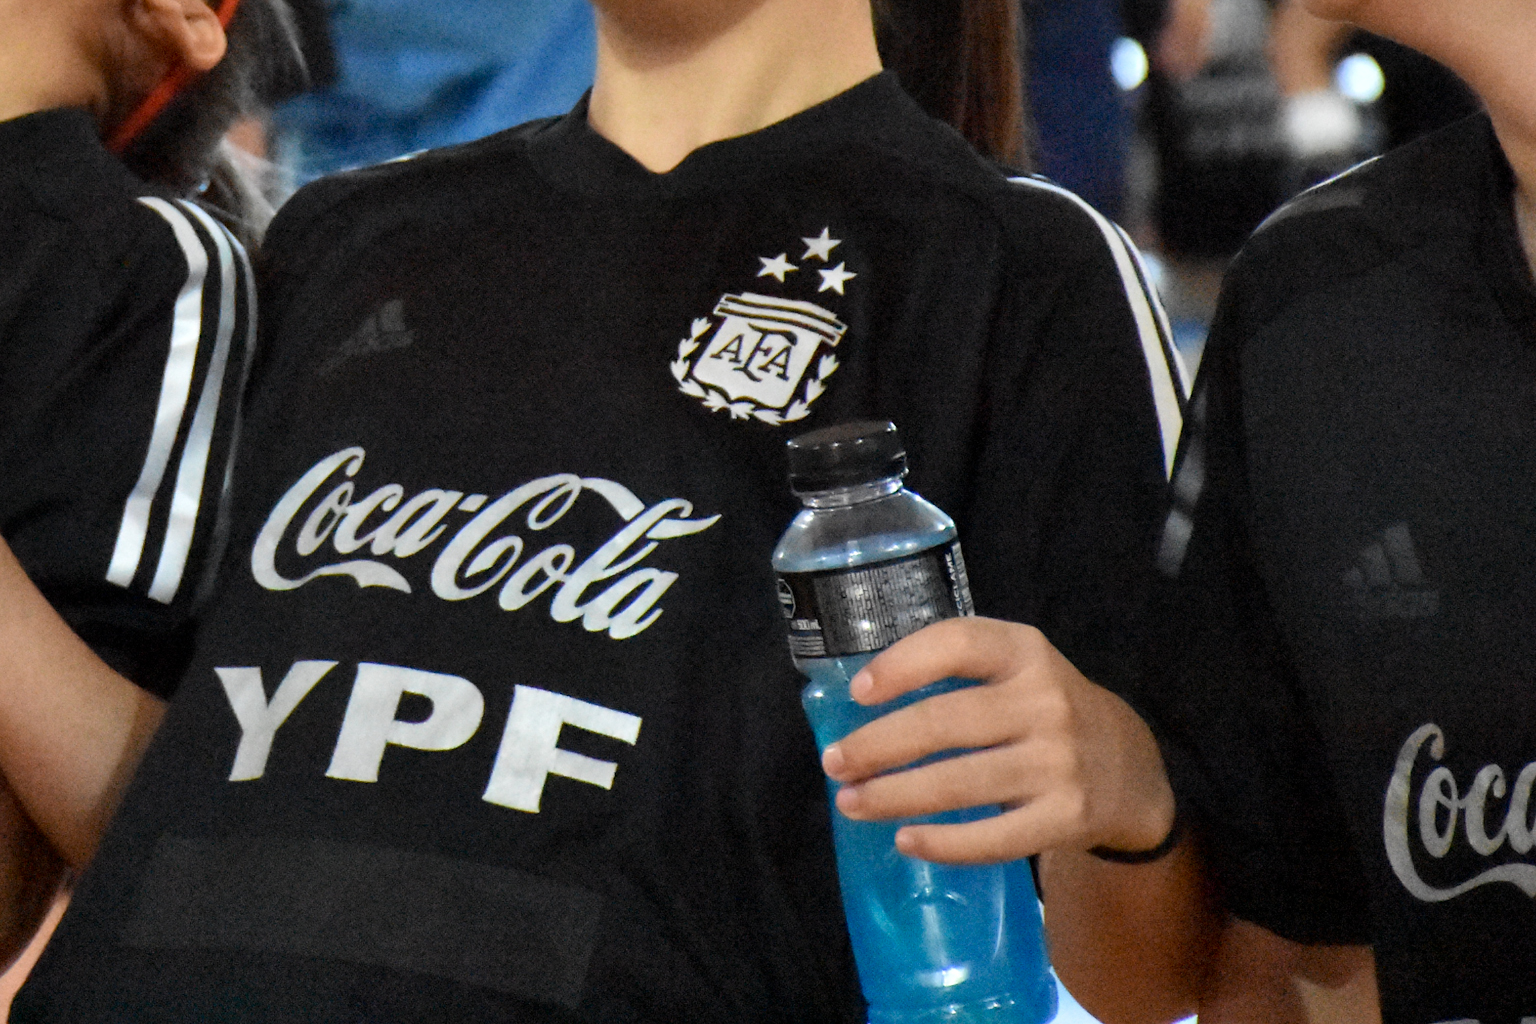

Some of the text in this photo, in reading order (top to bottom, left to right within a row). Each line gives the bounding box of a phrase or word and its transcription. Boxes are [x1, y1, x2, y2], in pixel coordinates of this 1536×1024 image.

[710, 322, 798, 382] AFA
[251, 446, 721, 639] Coca-Cola
[214, 660, 643, 813] YPF
